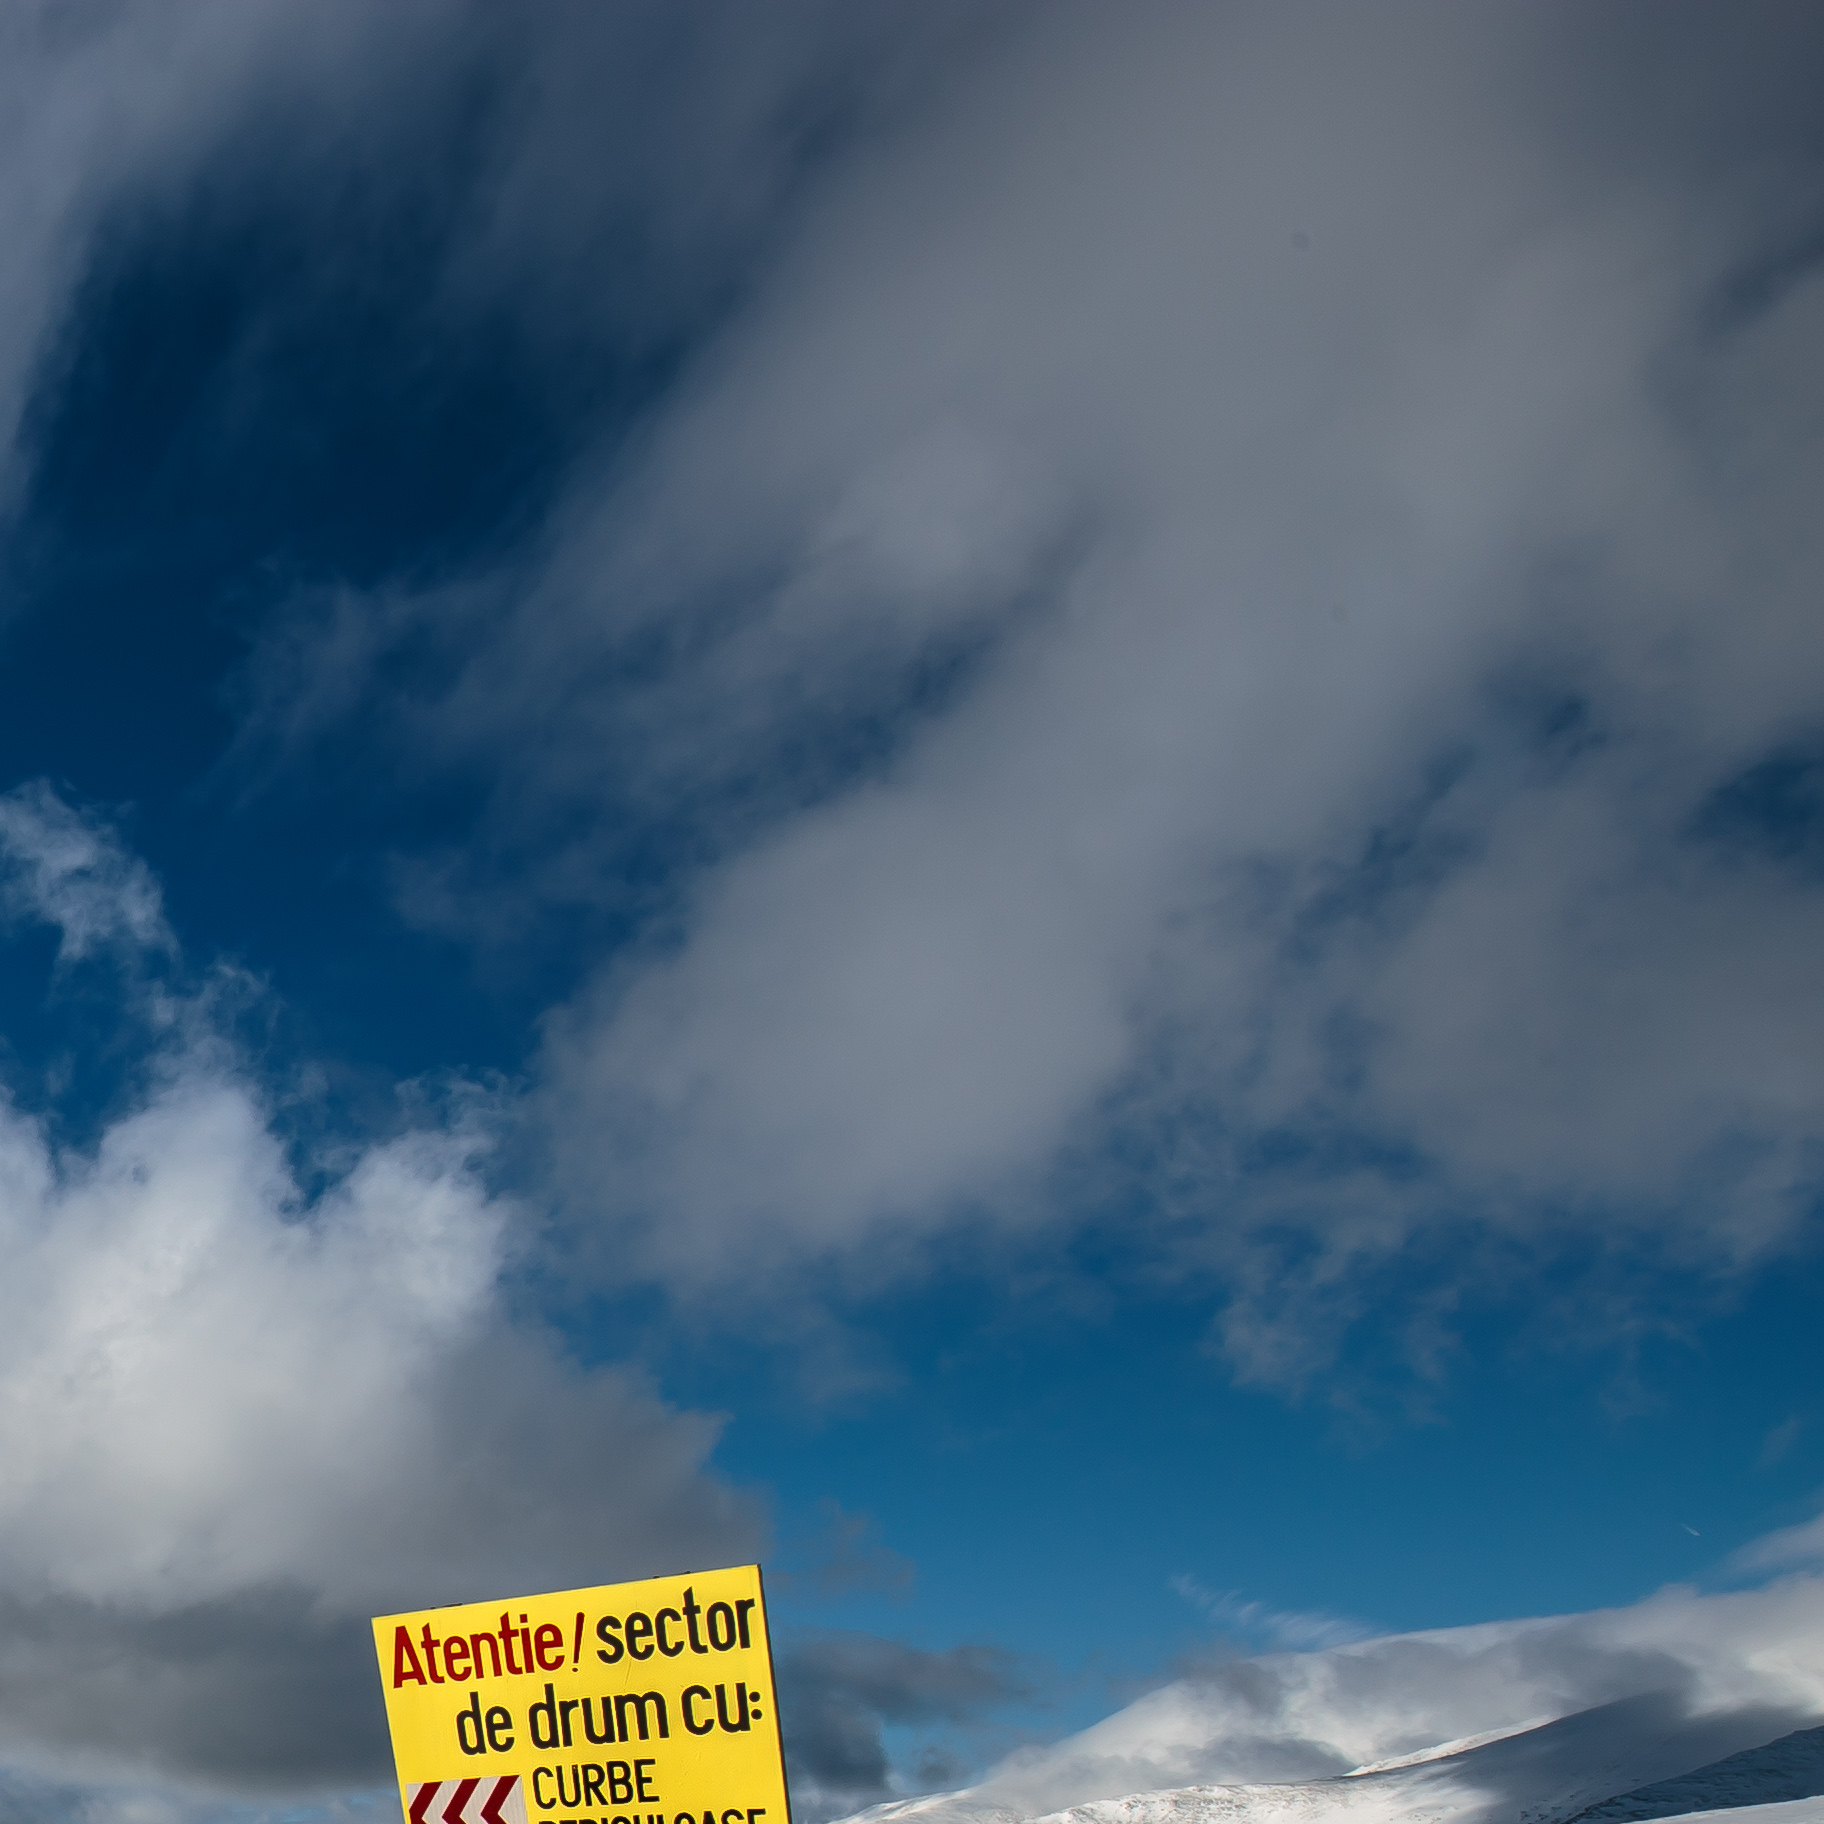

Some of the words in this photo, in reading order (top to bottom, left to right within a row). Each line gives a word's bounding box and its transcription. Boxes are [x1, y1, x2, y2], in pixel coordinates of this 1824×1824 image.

[393, 1611, 585, 1689] Atentie!
[596, 1586, 756, 1665] sector
[456, 1691, 515, 1756] de
[528, 1682, 670, 1750] drum
[681, 1681, 763, 1736] cu:
[532, 1758, 661, 1810] CURBE
